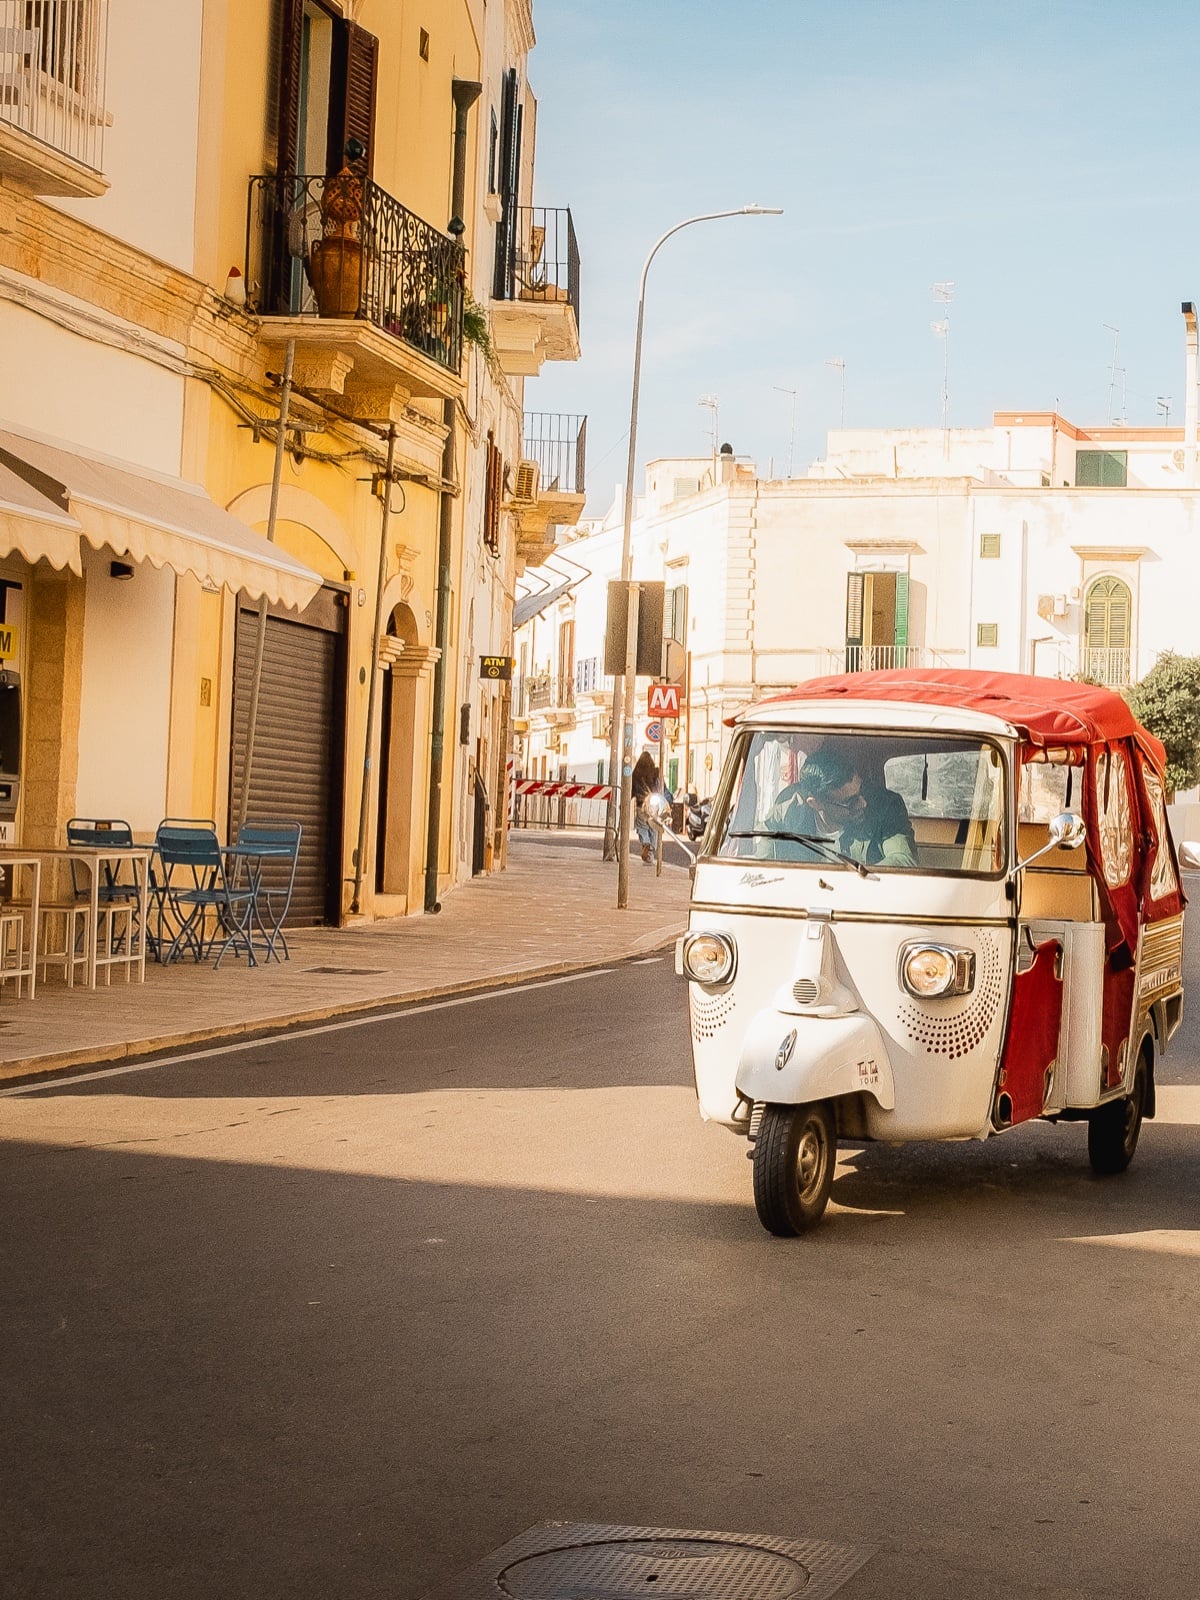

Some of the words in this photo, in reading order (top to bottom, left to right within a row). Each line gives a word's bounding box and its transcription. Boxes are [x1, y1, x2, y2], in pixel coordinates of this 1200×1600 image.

[484, 658, 506, 667] ATM
[650, 687, 679, 710] M
[860, 1076, 878, 1085] TOUR
